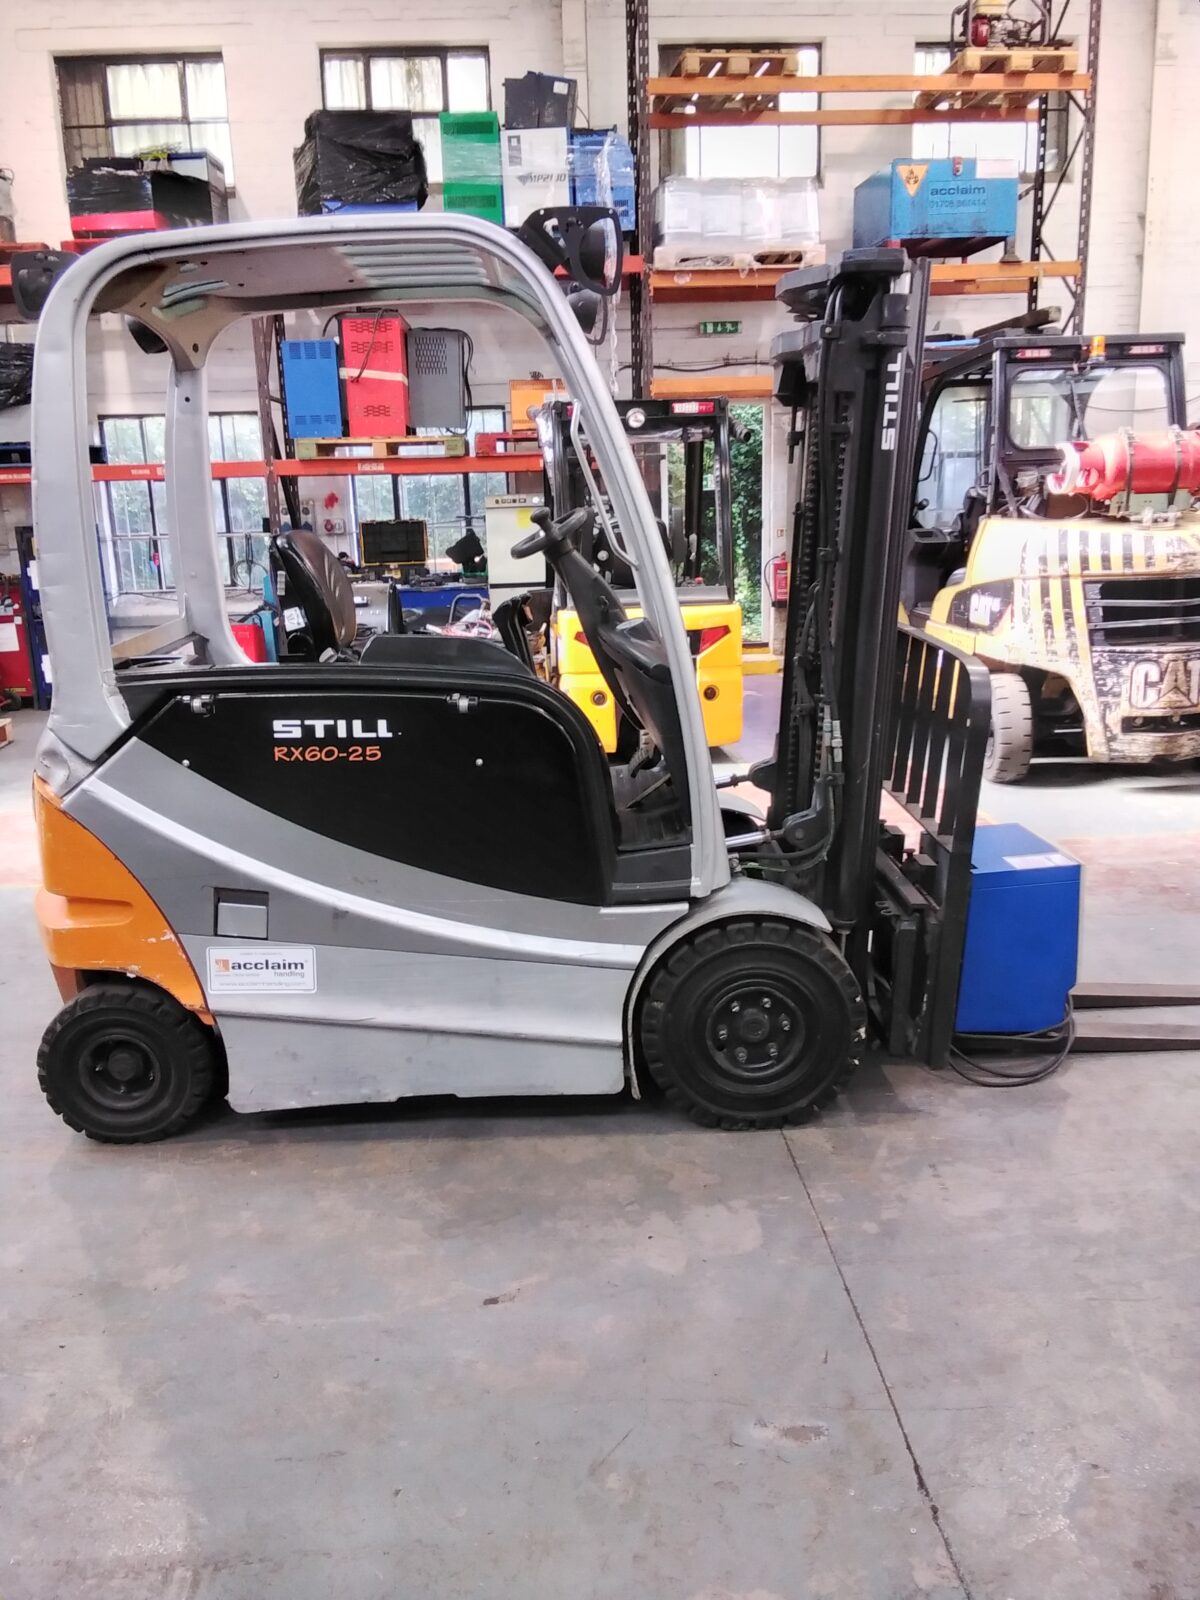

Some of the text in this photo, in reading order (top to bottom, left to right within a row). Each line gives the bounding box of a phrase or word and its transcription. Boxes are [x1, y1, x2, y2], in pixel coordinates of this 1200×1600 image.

[930, 185, 986, 196] acclaim
[881, 352, 902, 450] STILL
[1131, 660, 1200, 708] CAT
[273, 719, 393, 738] STILL
[274, 746, 381, 761] RX60-25
[231, 959, 304, 970] acclaim
